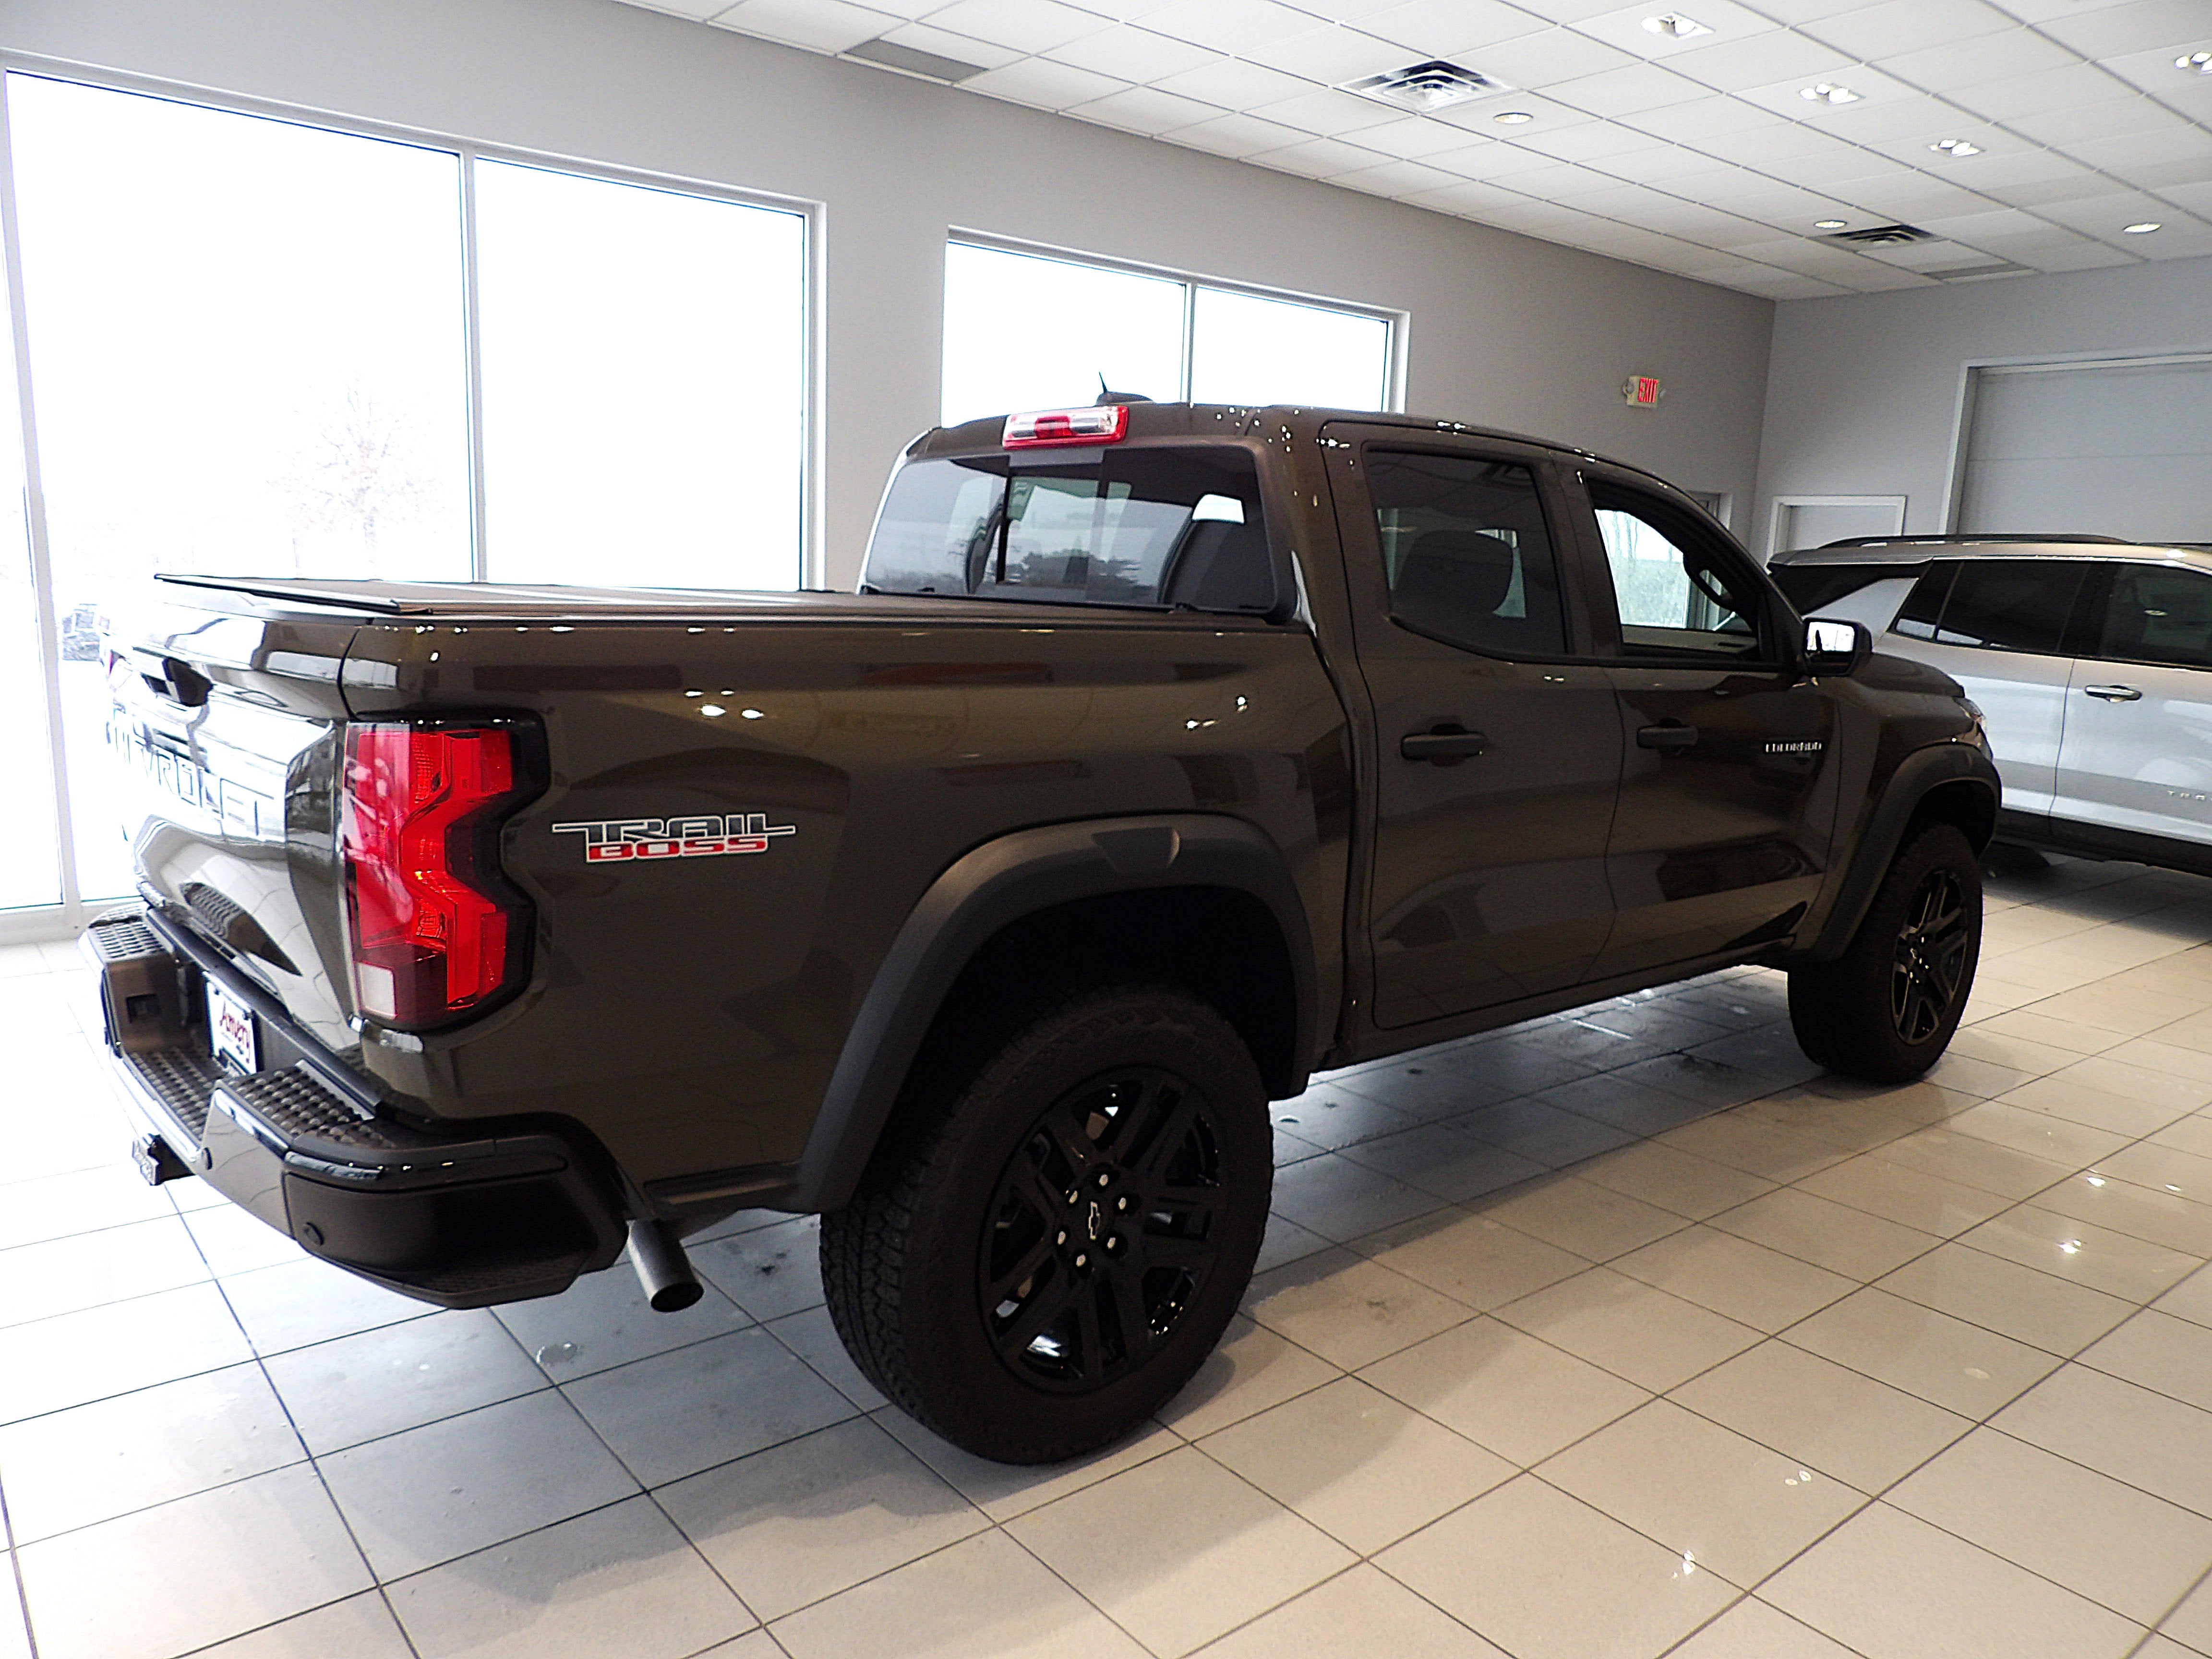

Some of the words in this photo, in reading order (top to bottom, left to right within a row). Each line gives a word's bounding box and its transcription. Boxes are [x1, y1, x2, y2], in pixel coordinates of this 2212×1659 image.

[1638, 377, 1659, 403] EXIT
[107, 720, 275, 836] VROLET
[552, 813, 797, 843] TRAIL
[586, 833, 769, 863] BOSS
